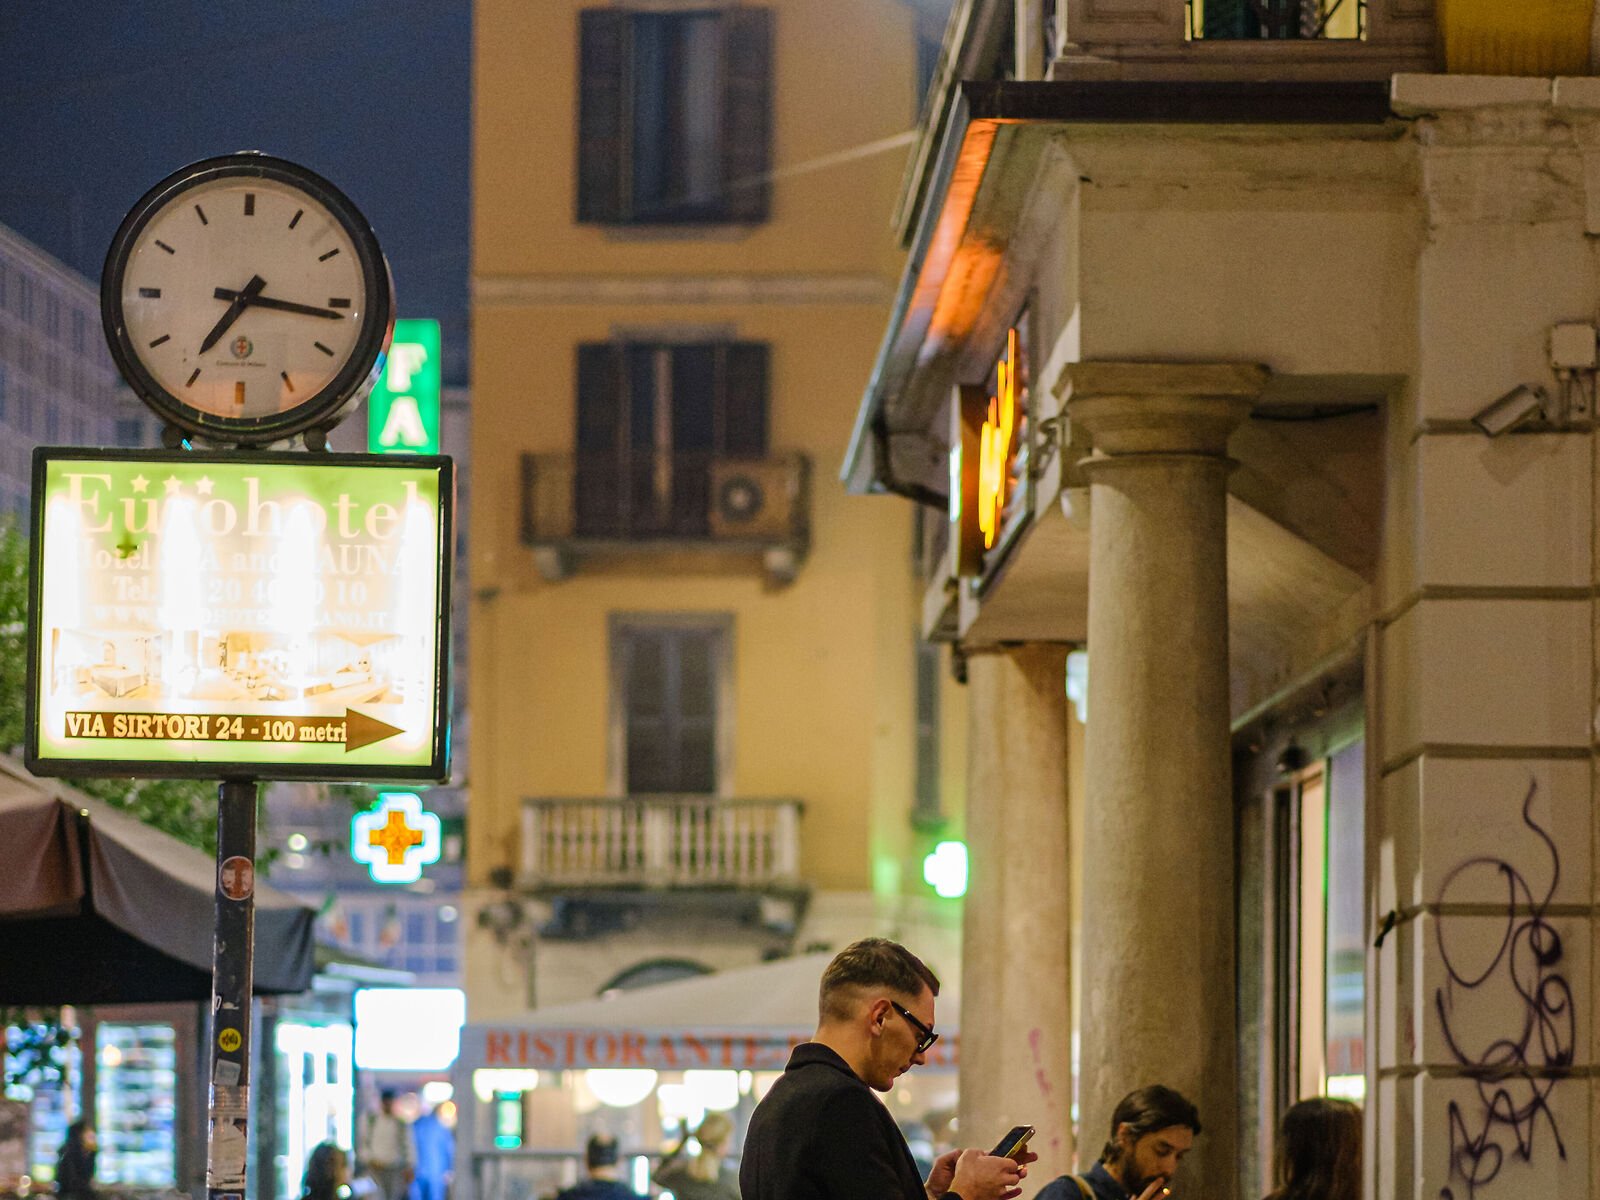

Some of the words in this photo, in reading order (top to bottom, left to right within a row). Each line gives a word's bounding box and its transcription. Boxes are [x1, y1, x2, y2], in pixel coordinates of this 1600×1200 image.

[66, 713, 107, 737] VIA
[113, 714, 210, 740] SIRTORI
[215, 716, 245, 740] 24
[263, 721, 295, 741] 100
[299, 722, 348, 742] metri
[485, 1030, 771, 1067] RISTORANTE
